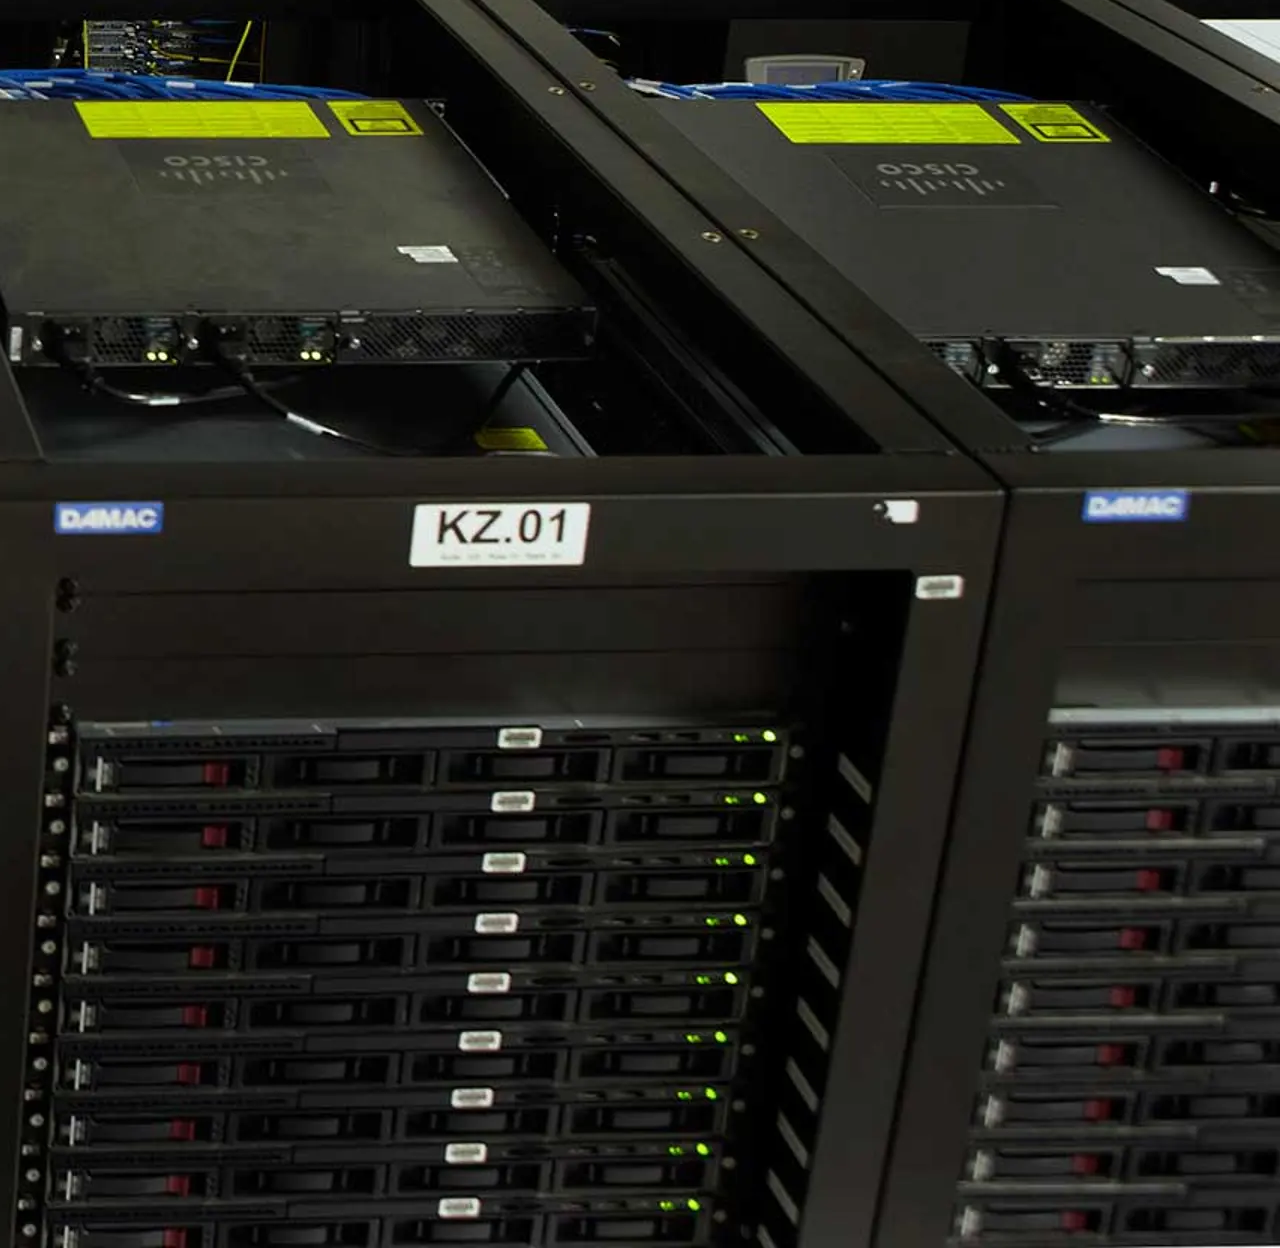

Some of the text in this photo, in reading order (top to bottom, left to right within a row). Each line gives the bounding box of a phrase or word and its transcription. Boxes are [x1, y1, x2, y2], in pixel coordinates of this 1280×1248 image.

[1087, 496, 1182, 517] DAMAC
[59, 507, 157, 529] DAMAC
[436, 509, 567, 544] KZ.01
